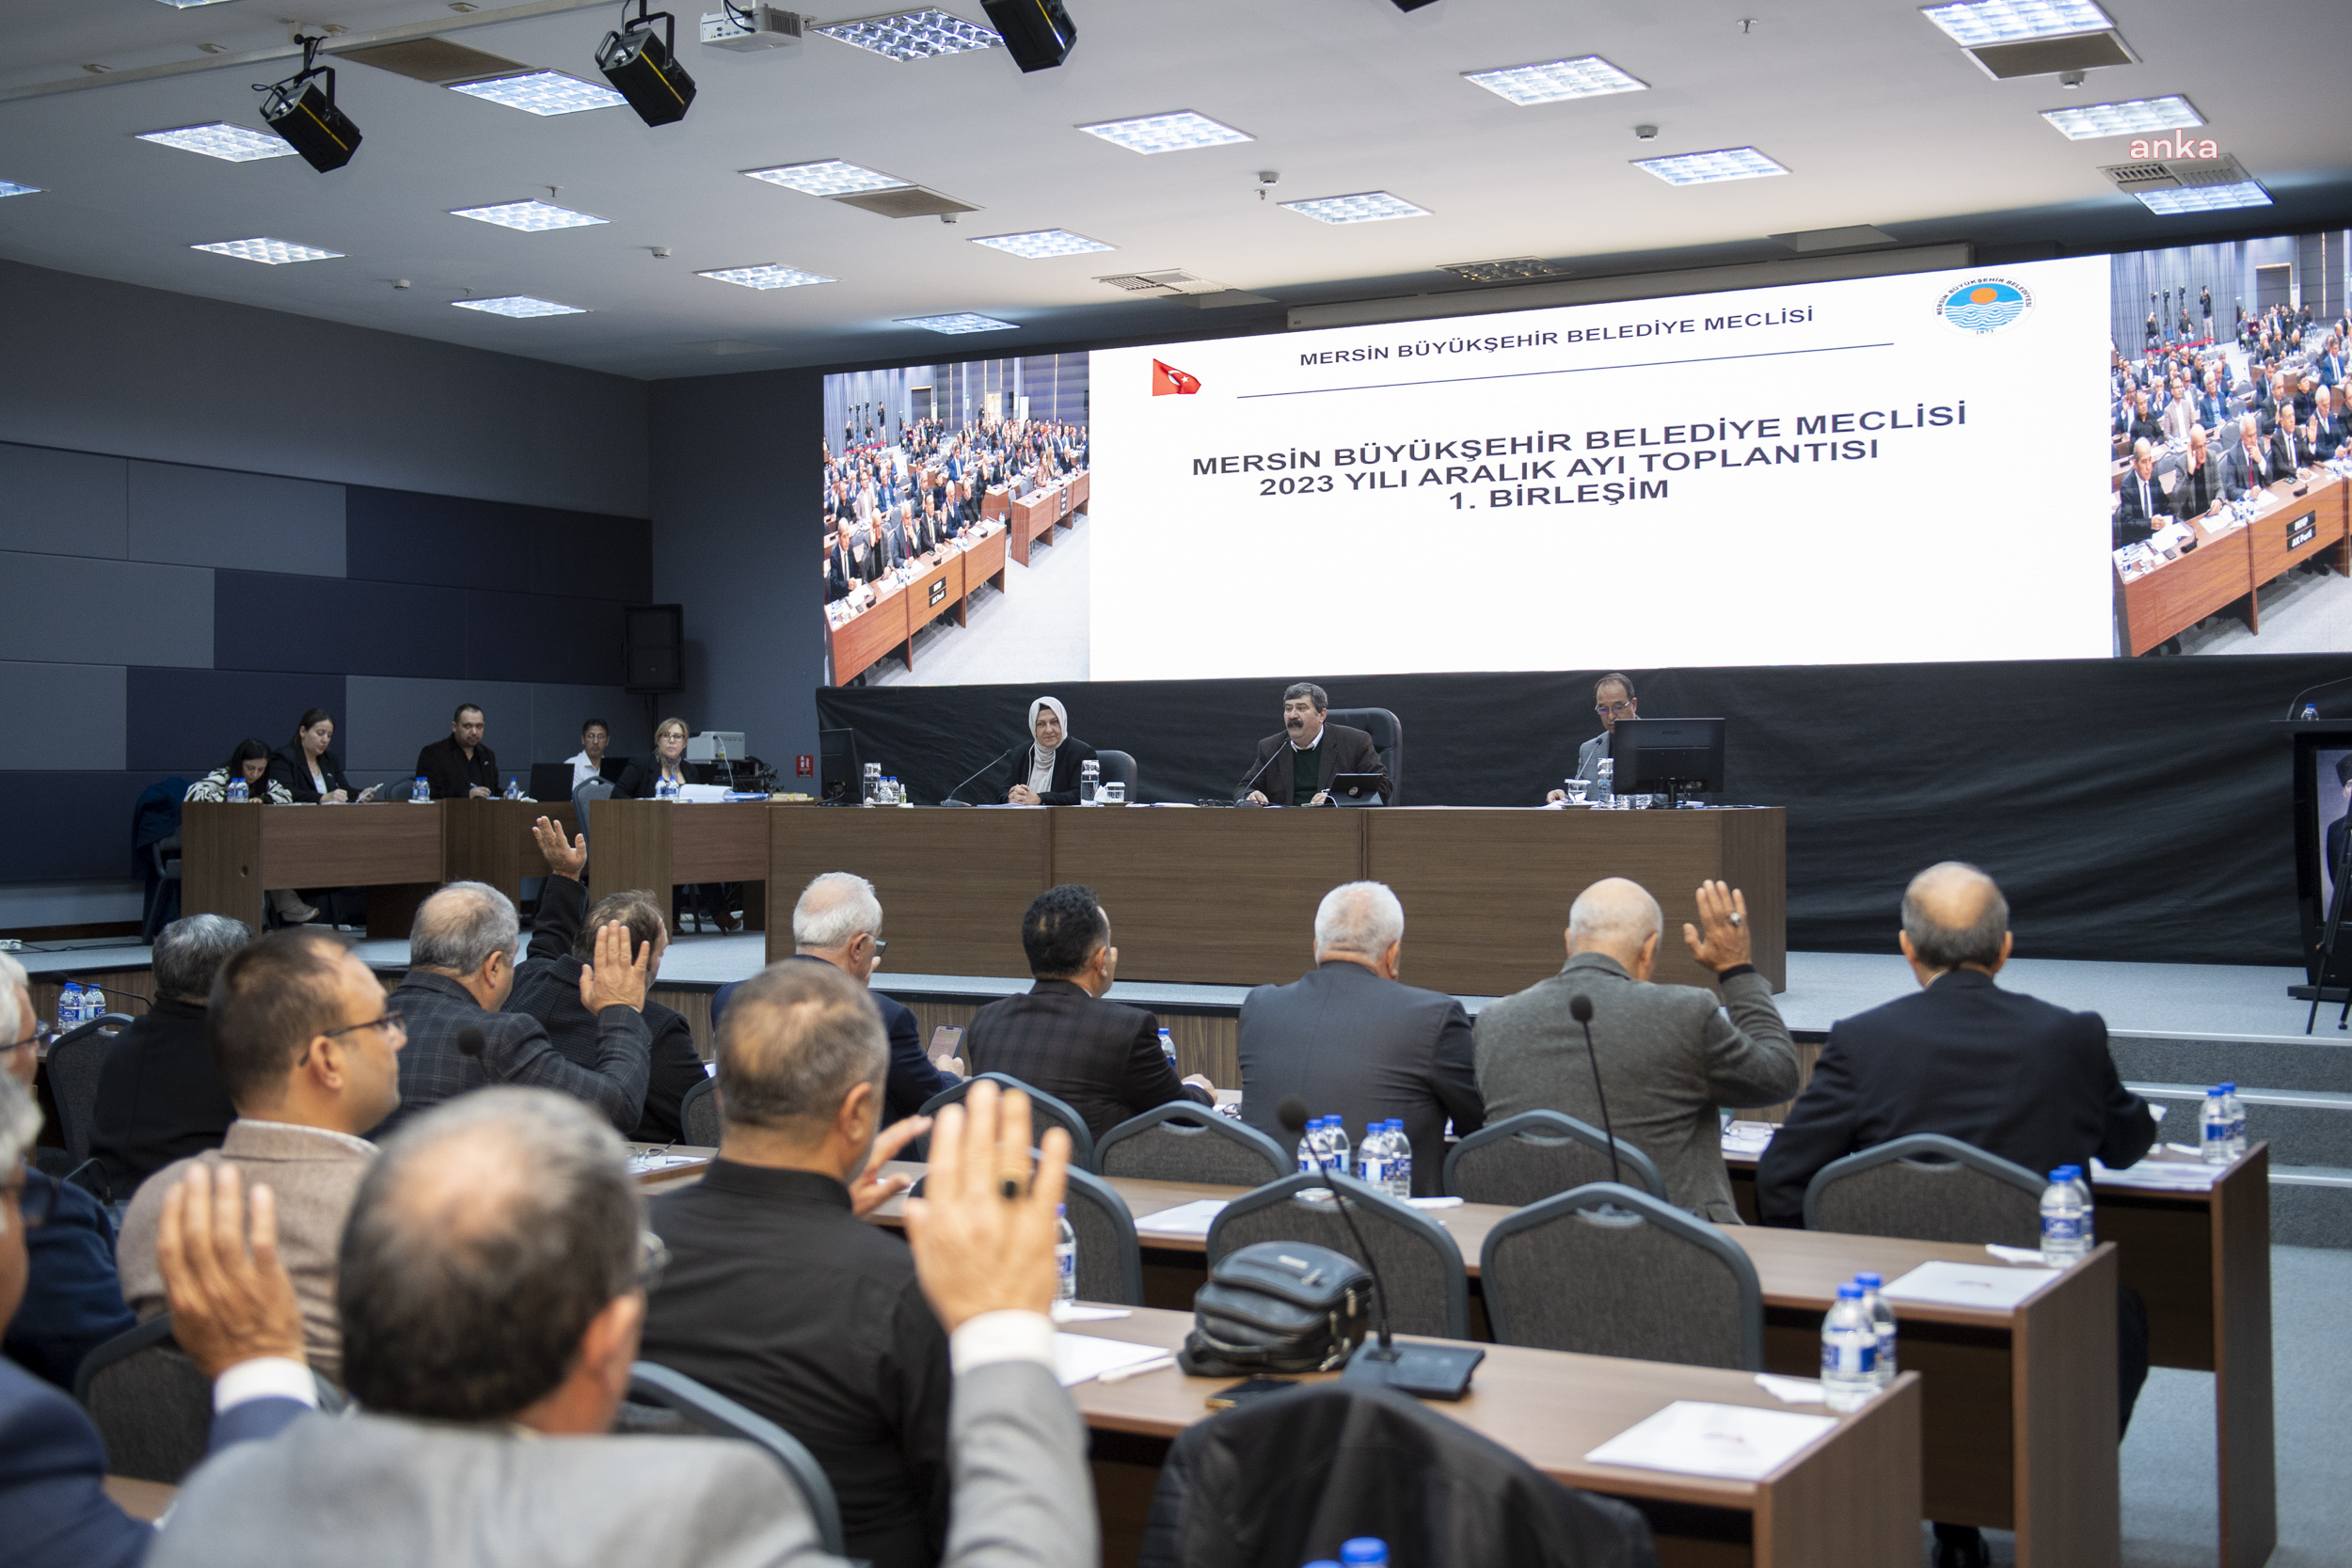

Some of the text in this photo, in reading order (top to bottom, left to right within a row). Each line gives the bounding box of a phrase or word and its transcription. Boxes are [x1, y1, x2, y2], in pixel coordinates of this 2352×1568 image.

[1300, 305, 1813, 366] MERSİN BÜYÜKŞEHİR BELEDİYE MECLİSİ
[1193, 400, 1965, 476] MERSİN BÜYÜKŞEHİR BELEDİYE MECLİSİ
[1259, 438, 1878, 497] 2023 YILI ARALIK AYI TOPLANTISI
[1449, 477, 1668, 510] 1. BİRLEŞİM
